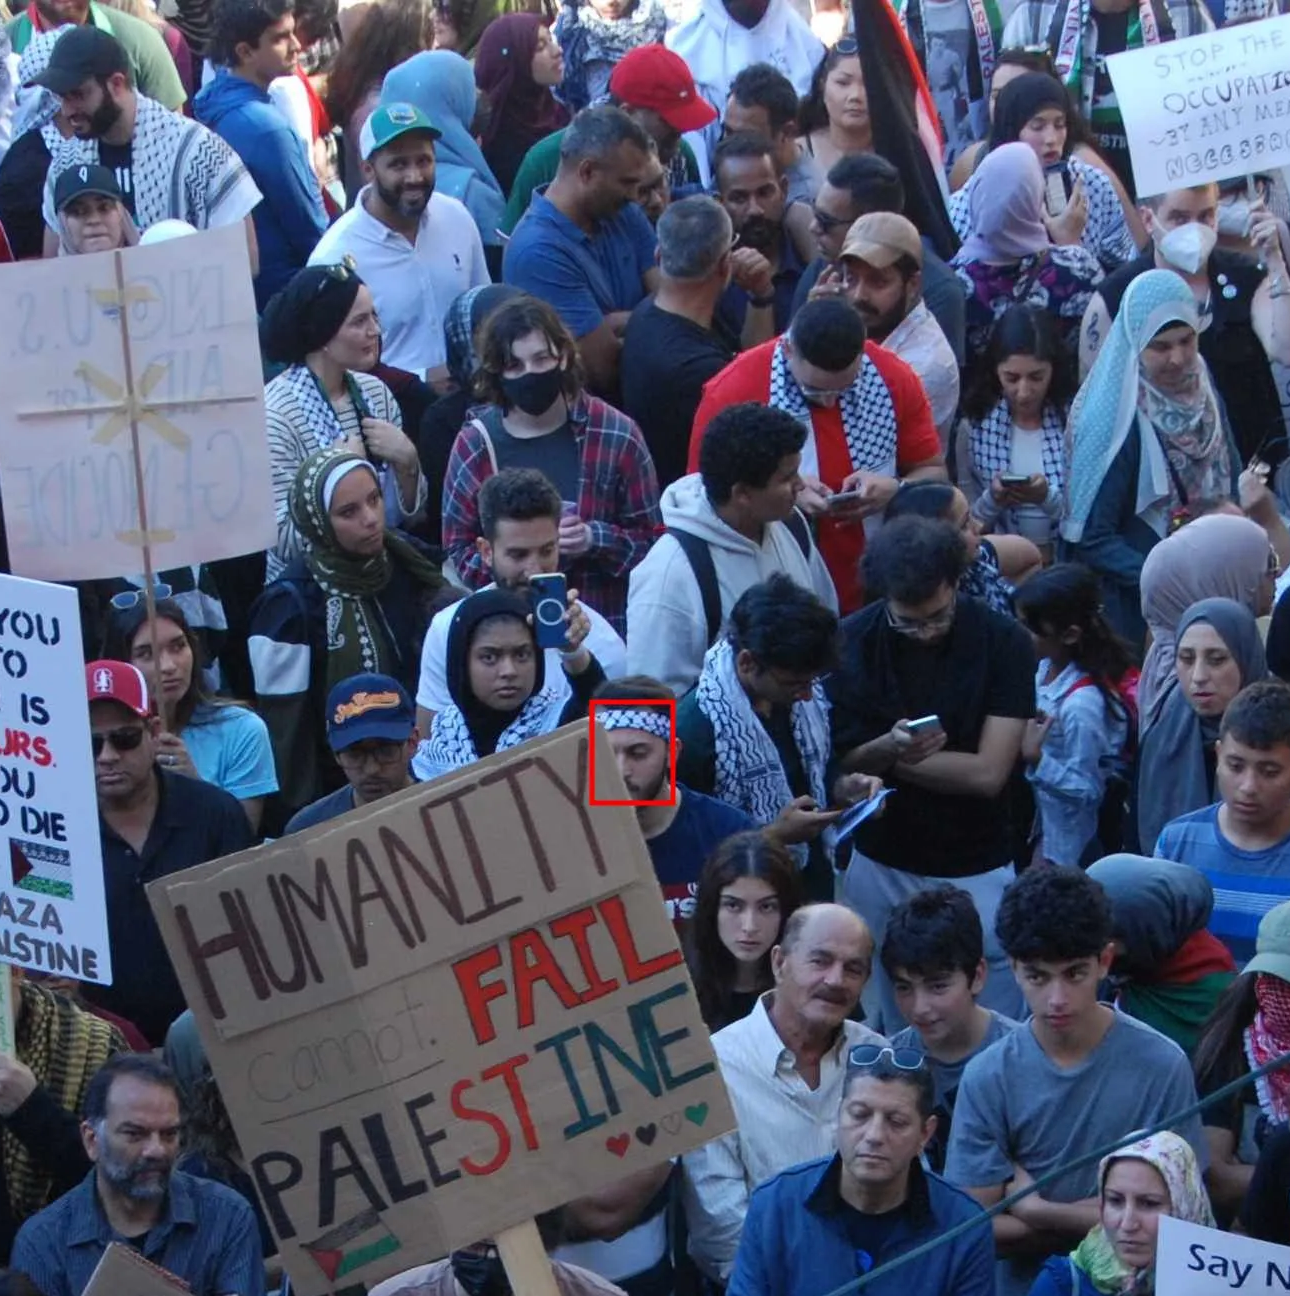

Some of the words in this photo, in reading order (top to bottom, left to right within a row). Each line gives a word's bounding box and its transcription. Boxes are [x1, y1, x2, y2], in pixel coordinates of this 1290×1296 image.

[1155, 43, 1224, 79] STOP
[1239, 29, 1285, 55] THE
[1200, 106, 1243, 137] ANY
[21, 693, 50, 725] IS
[21, 807, 67, 842] DIE
[175, 738, 608, 1020] HUMANITY
[451, 895, 683, 1046] FAIL
[251, 981, 716, 1240] PALESTINE
[1188, 1244, 1253, 1288] Say
